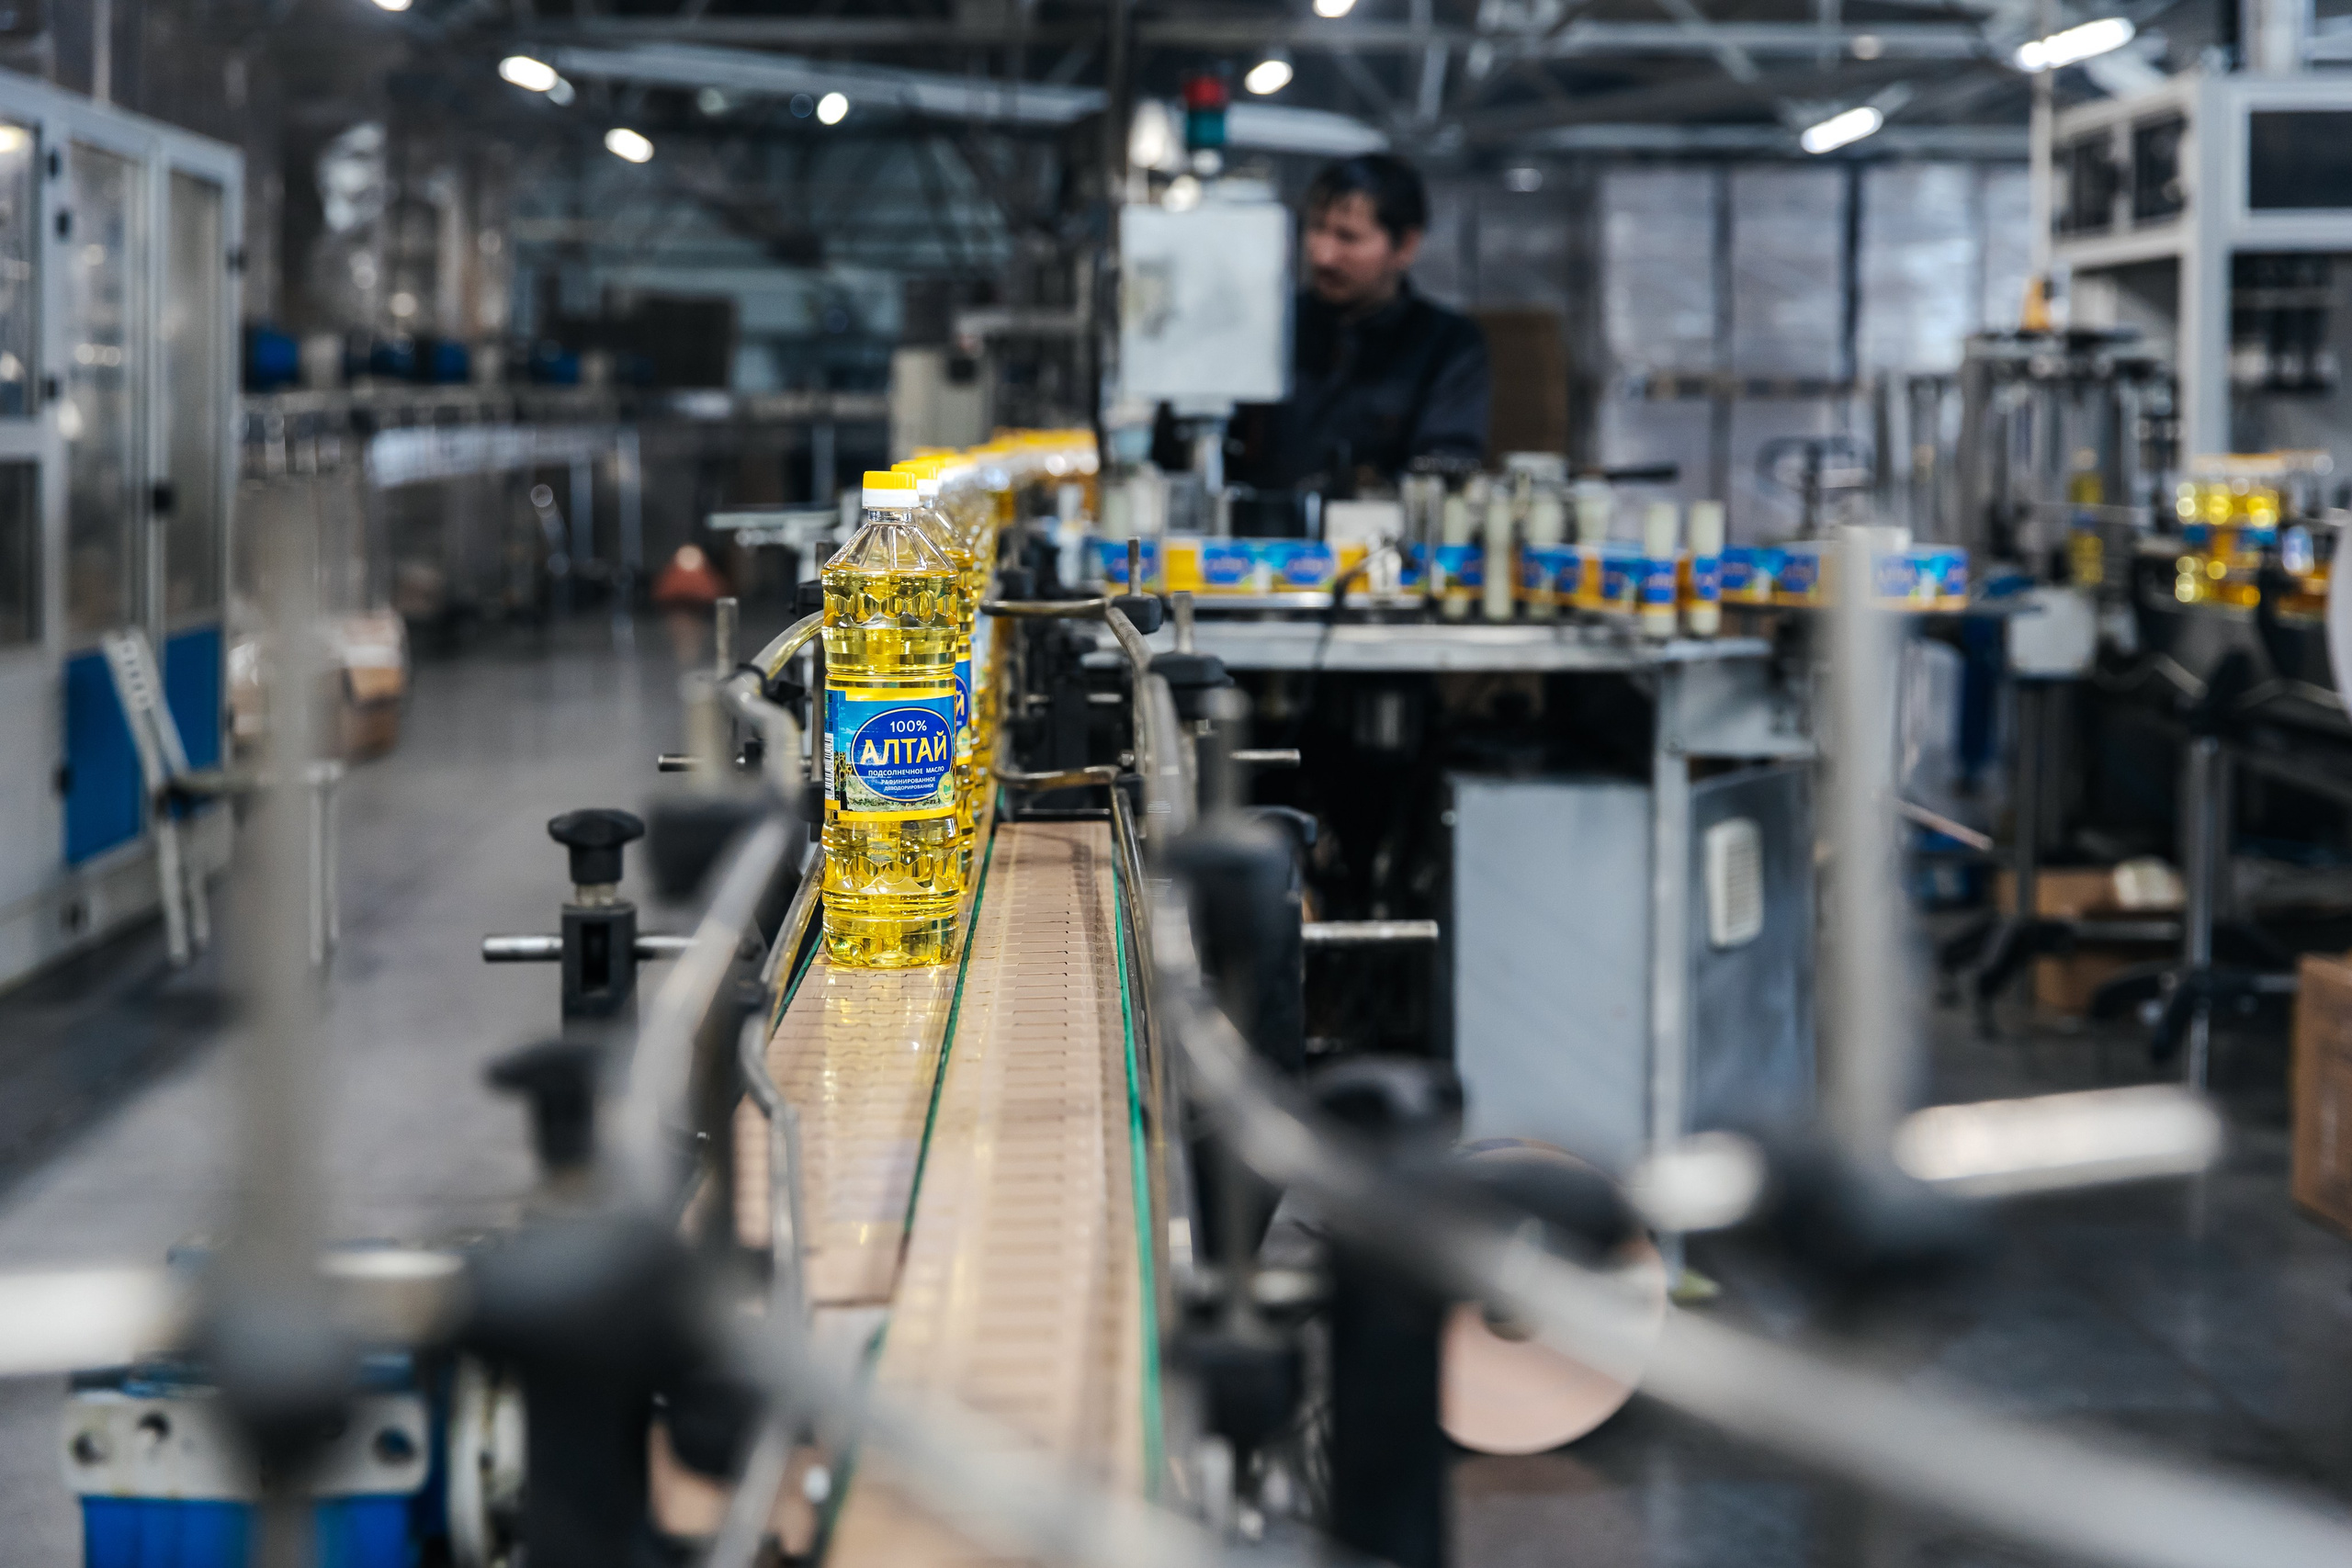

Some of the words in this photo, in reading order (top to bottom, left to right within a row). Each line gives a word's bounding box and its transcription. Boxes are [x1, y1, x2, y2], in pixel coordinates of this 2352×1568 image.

[889, 720, 927, 732] 100%
[860, 730, 947, 765] АЛТАЙ
[868, 768, 923, 777] ПОДСОЛНЕЧНОЕ
[926, 765, 944, 773] МАСЛО
[881, 776, 936, 784] РАФИНИРОВАННОЕ
